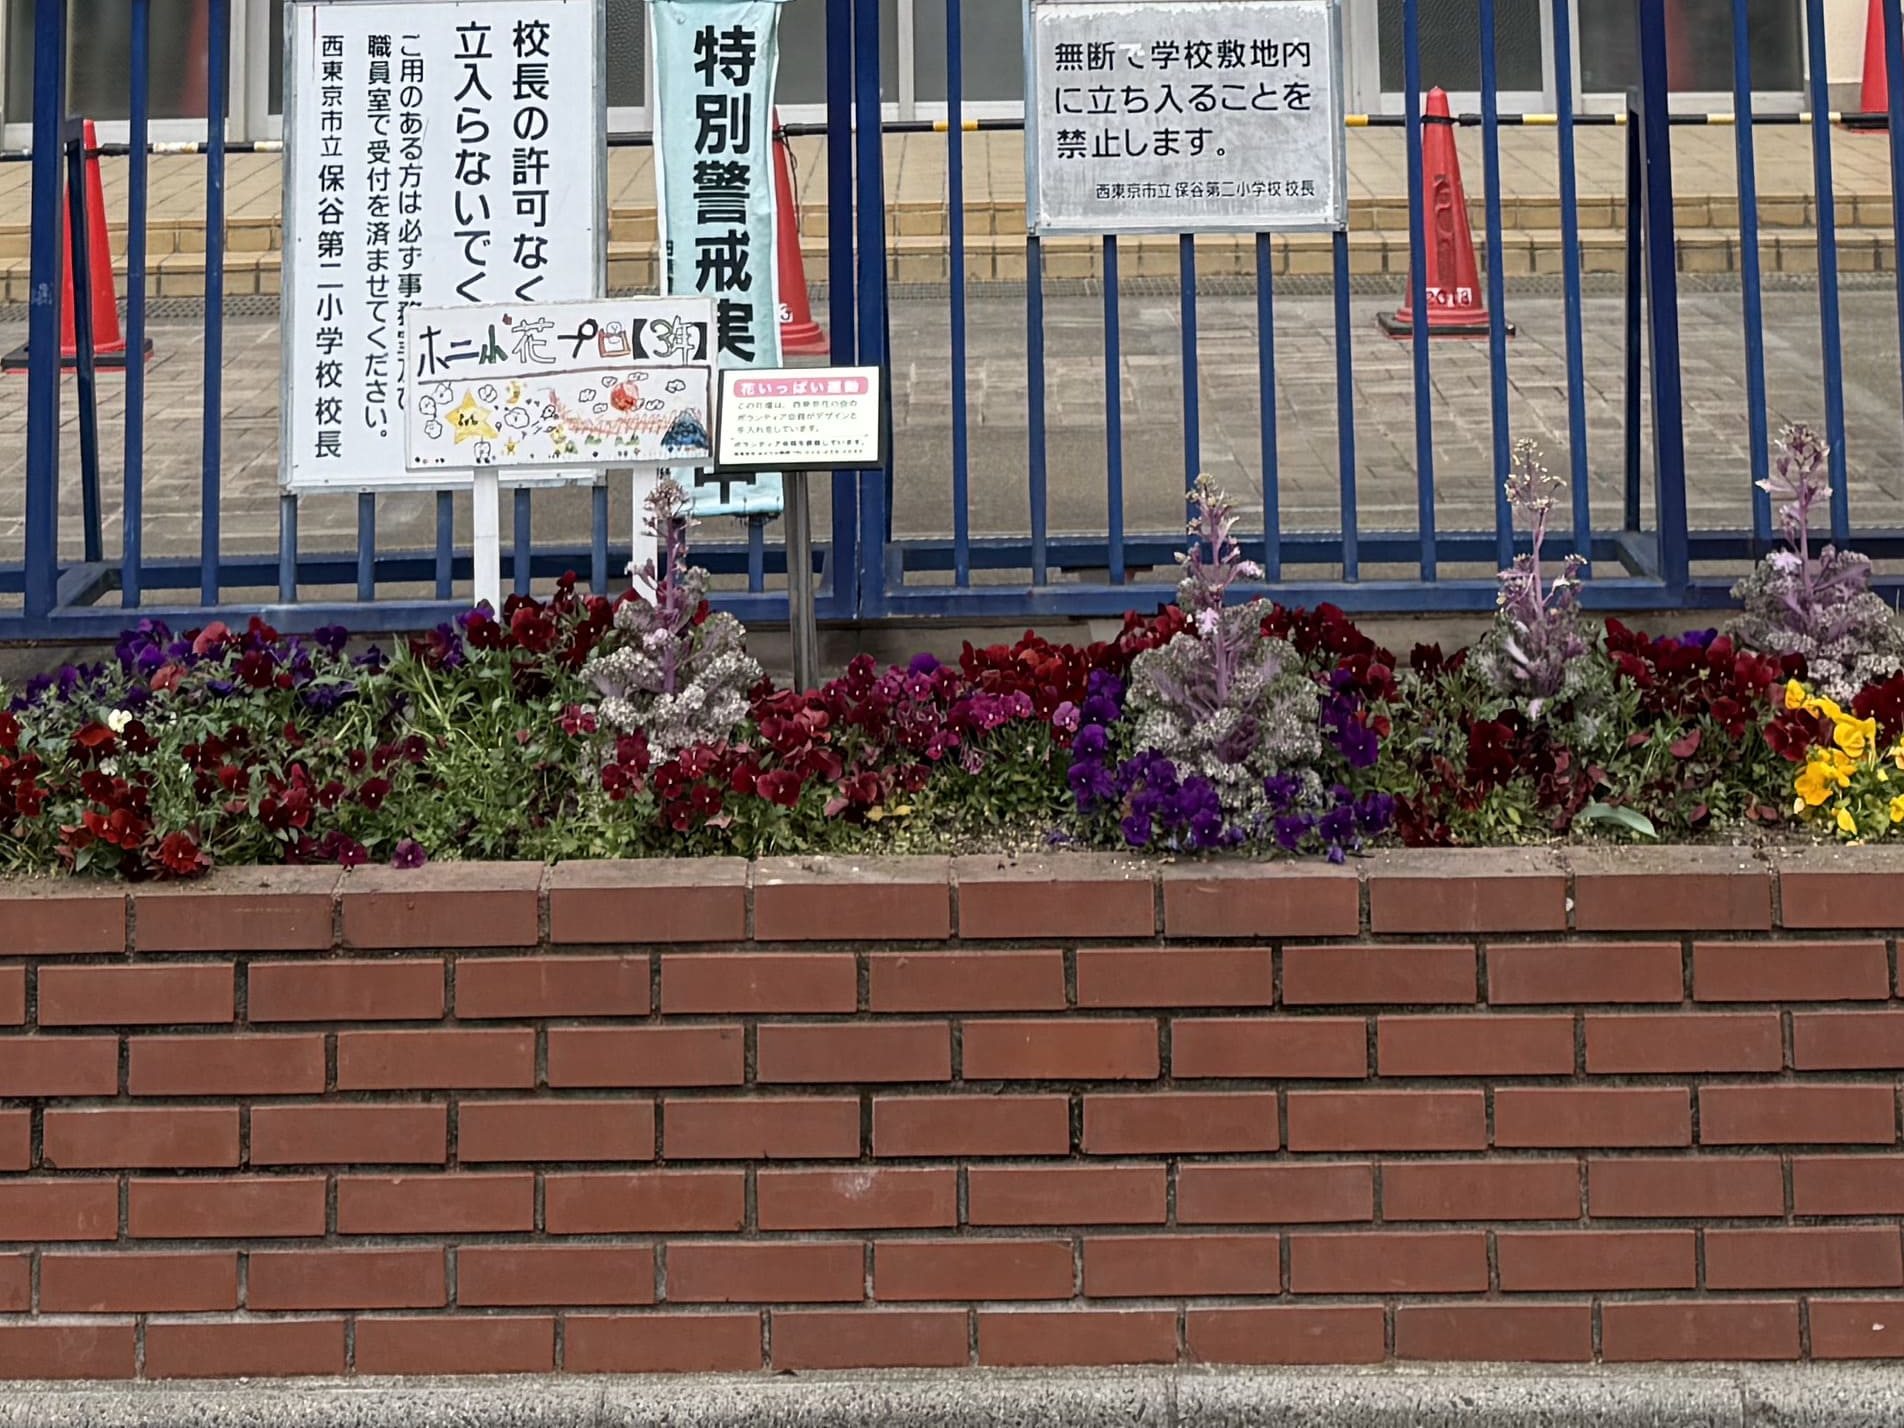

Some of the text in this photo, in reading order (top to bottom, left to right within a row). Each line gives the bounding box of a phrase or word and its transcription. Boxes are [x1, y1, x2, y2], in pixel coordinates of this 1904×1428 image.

[1056, 82, 1312, 115] に立ち入ることを
[1057, 127, 1227, 160] 禁止します。
[512, 19, 550, 302] 校長の許可なく
[365, 33, 392, 438] 職員室で受付を済ませてください。
[740, 380, 860, 396] 花いっぱい運動
